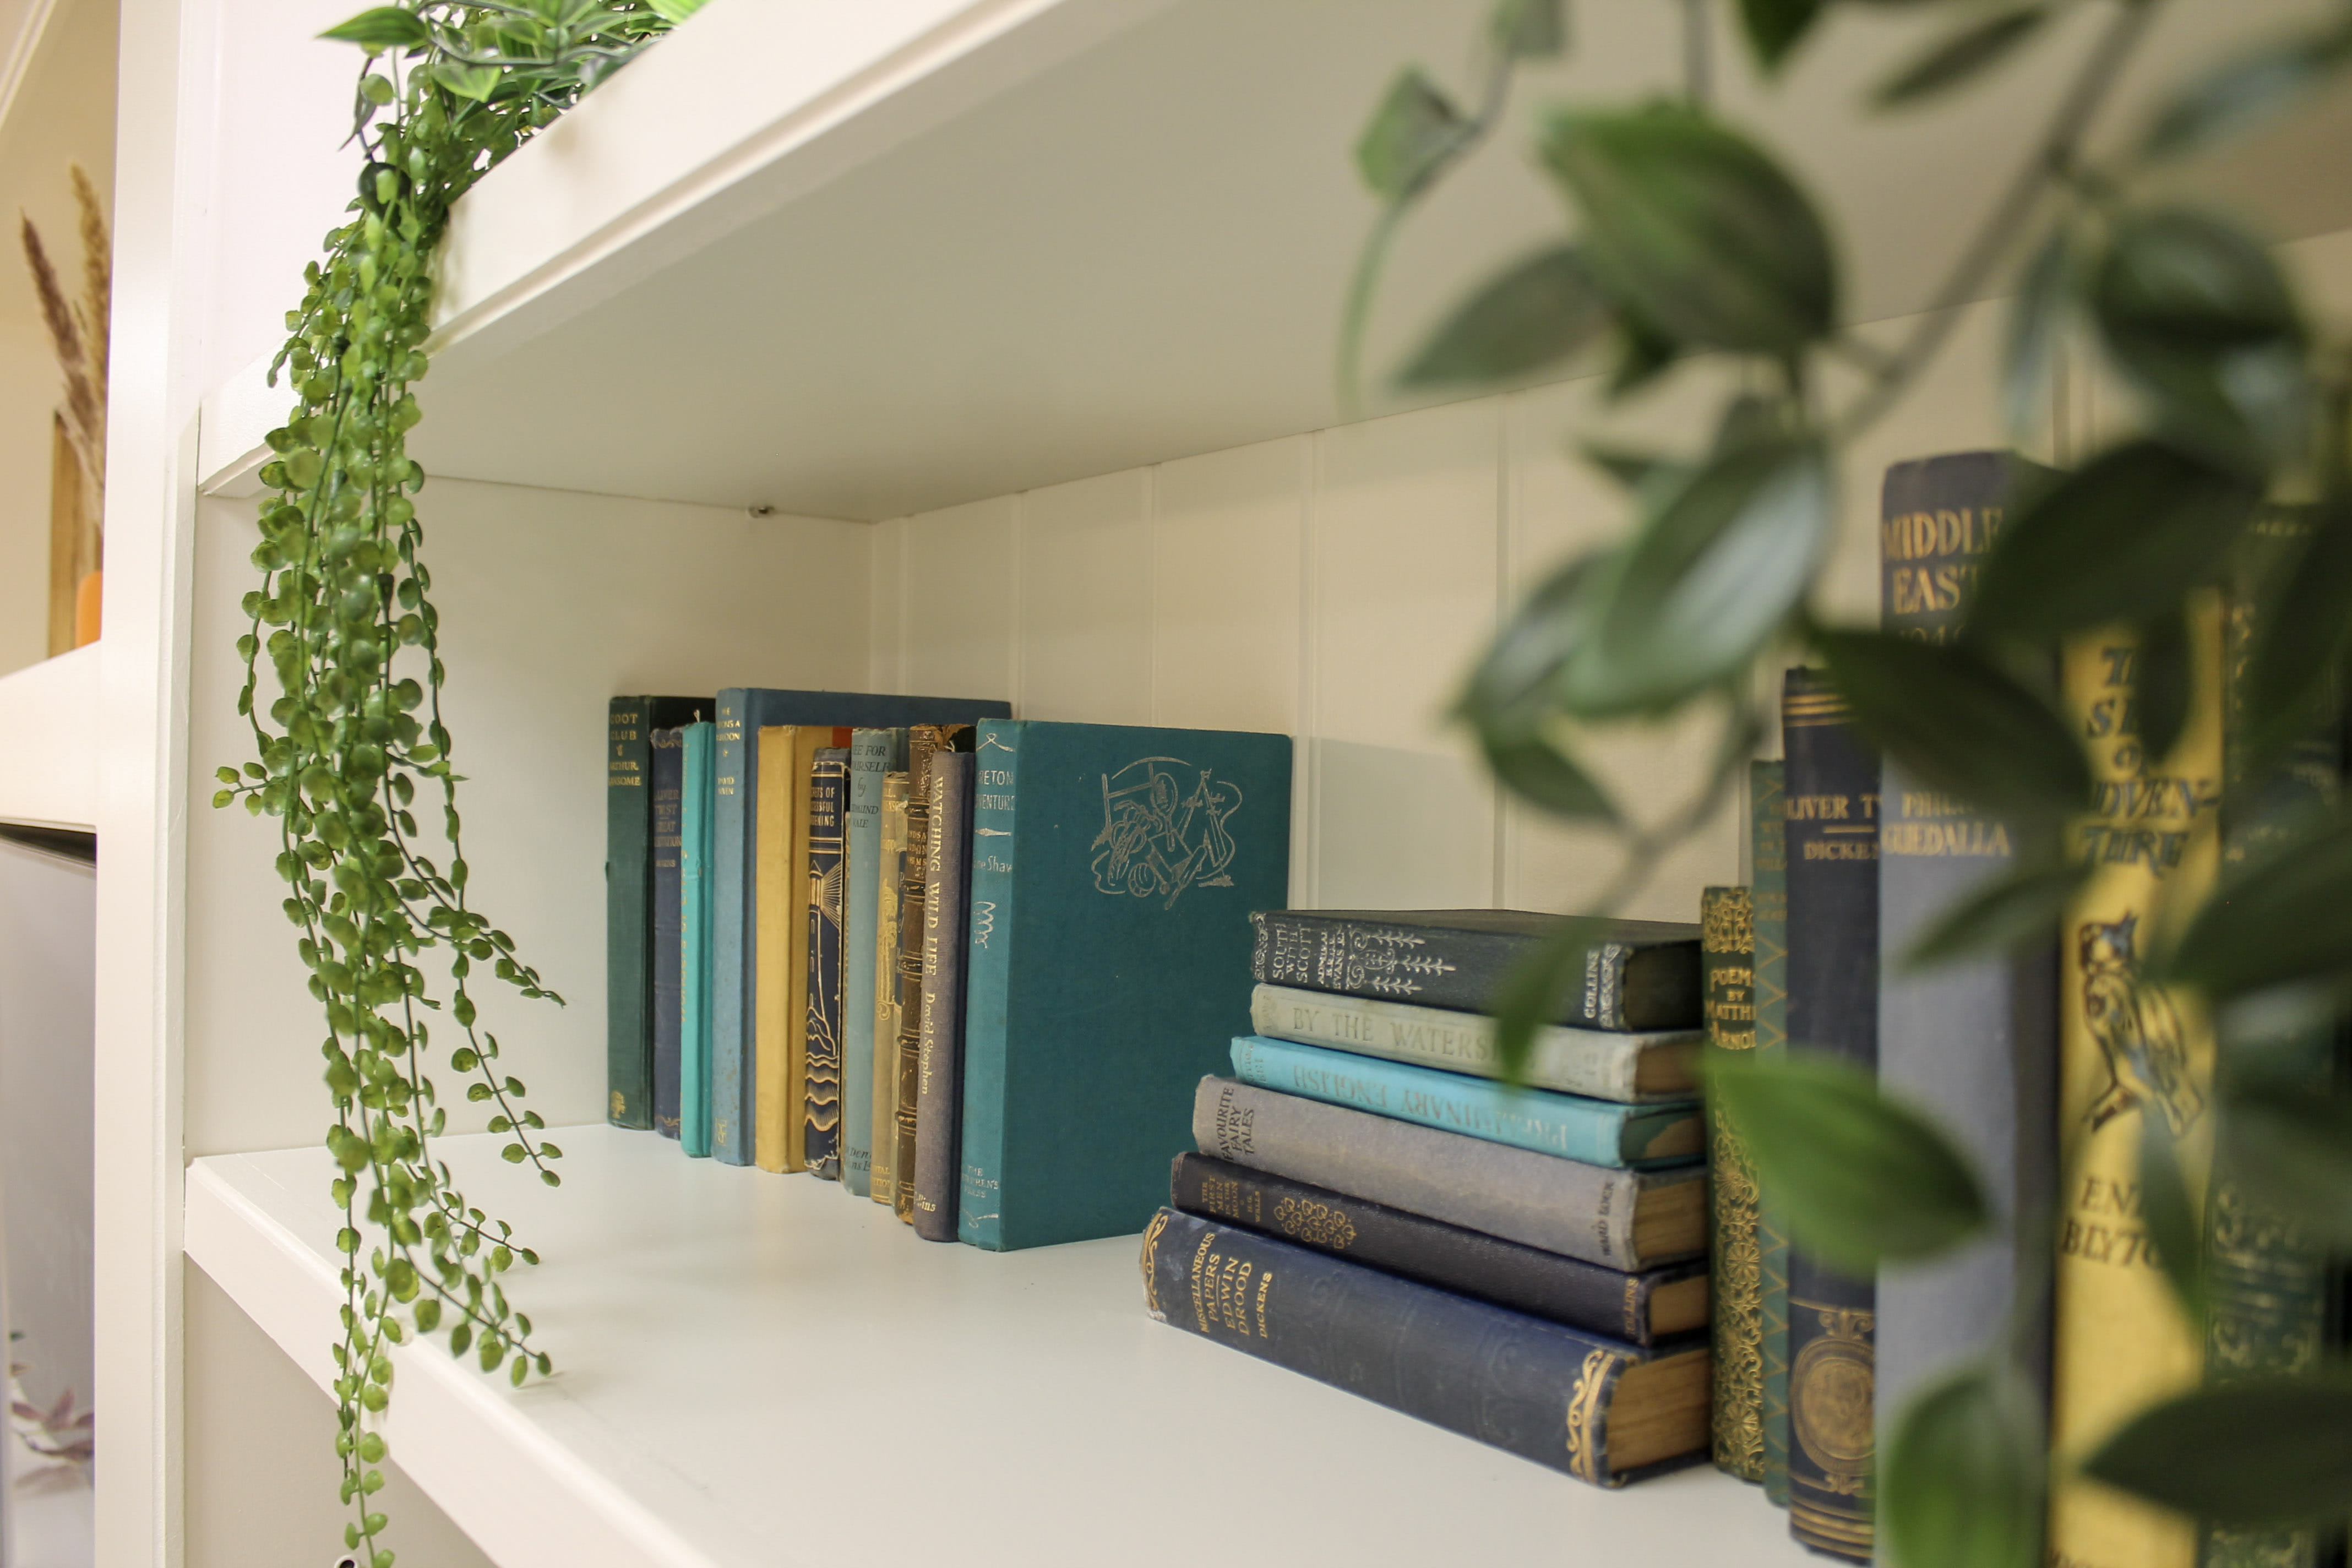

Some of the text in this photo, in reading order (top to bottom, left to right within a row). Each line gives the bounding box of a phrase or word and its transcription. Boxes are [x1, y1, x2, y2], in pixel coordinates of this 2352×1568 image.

[865, 745, 886, 756] FOR
[826, 787, 835, 798] OF
[1784, 794, 1849, 820] LIVER
[925, 776, 944, 976] WATCHING WILD LIFE
[988, 855, 1012, 873] Shaw
[1272, 922, 1289, 981] SOUTH
[1286, 931, 1298, 974] WITH
[1296, 927, 1312, 984] SCOTT
[1293, 1007, 1320, 1032] BY
[1332, 1014, 1373, 1041] THE
[1727, 990, 1746, 1001] BY
[921, 992, 935, 1095] David Stephen
[1216, 1087, 1234, 1161] FAVOURITE
[1228, 1106, 1243, 1152] FAIRY
[1240, 1108, 1255, 1155] TALES
[1191, 1233, 1216, 1333] MISCELLANEOUS
[1204, 1254, 1221, 1322] PAPERS
[1221, 1257, 1239, 1330] EDWIN
[1234, 1262, 1253, 1335] DROOD
[1256, 1272, 1273, 1339] DICKENS
